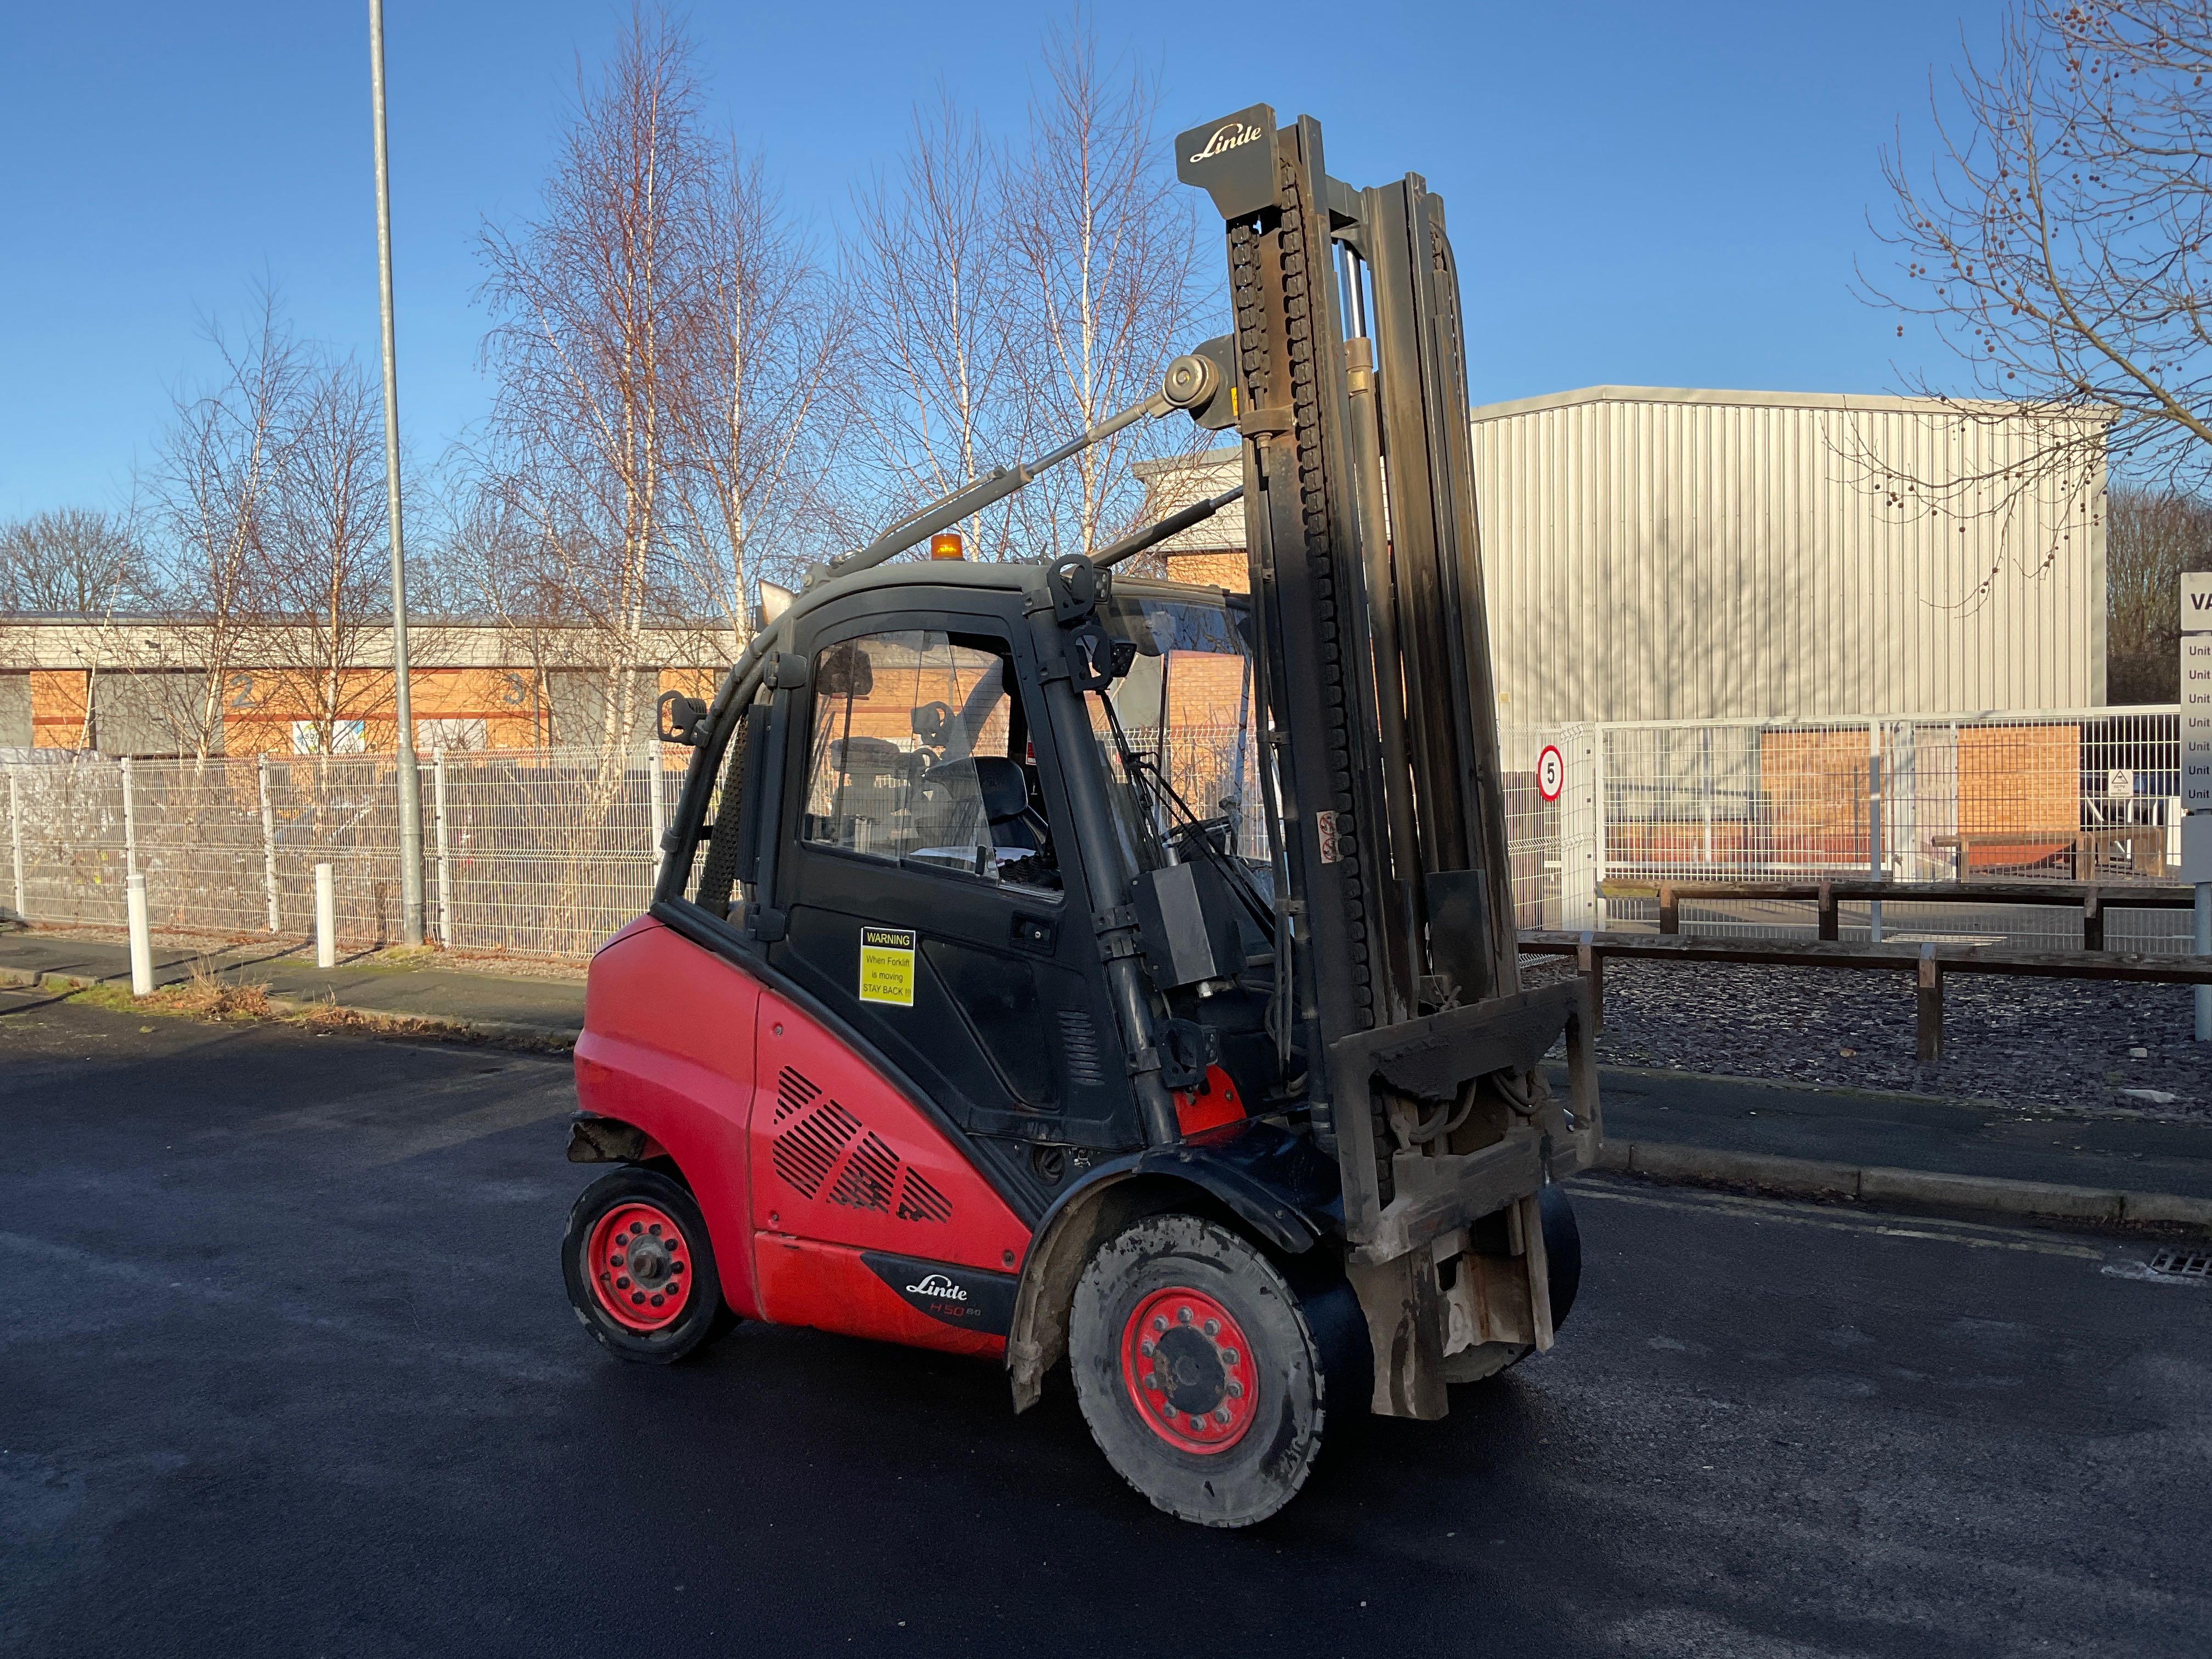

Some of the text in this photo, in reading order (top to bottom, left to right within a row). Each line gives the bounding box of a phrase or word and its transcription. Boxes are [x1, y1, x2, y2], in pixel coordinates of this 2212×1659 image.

[1189, 123, 1261, 163] Linde
[2189, 646, 2210, 656] Unit
[2189, 670, 2210, 680] Unit
[231, 673, 255, 707] 2
[2189, 694, 2210, 703] Unit
[2189, 718, 2210, 727] Unit
[2189, 742, 2210, 751] Unit
[1547, 762, 1555, 784] 5
[2188, 766, 2210, 775] Unit
[2188, 789, 2210, 799] Unit
[866, 932, 911, 946] WARNING
[866, 955, 910, 967] When Forklift
[871, 970, 904, 983] is moving
[863, 983, 882, 994] STAY
[883, 986, 904, 996] BACK
[906, 1274, 967, 1301] Linde
